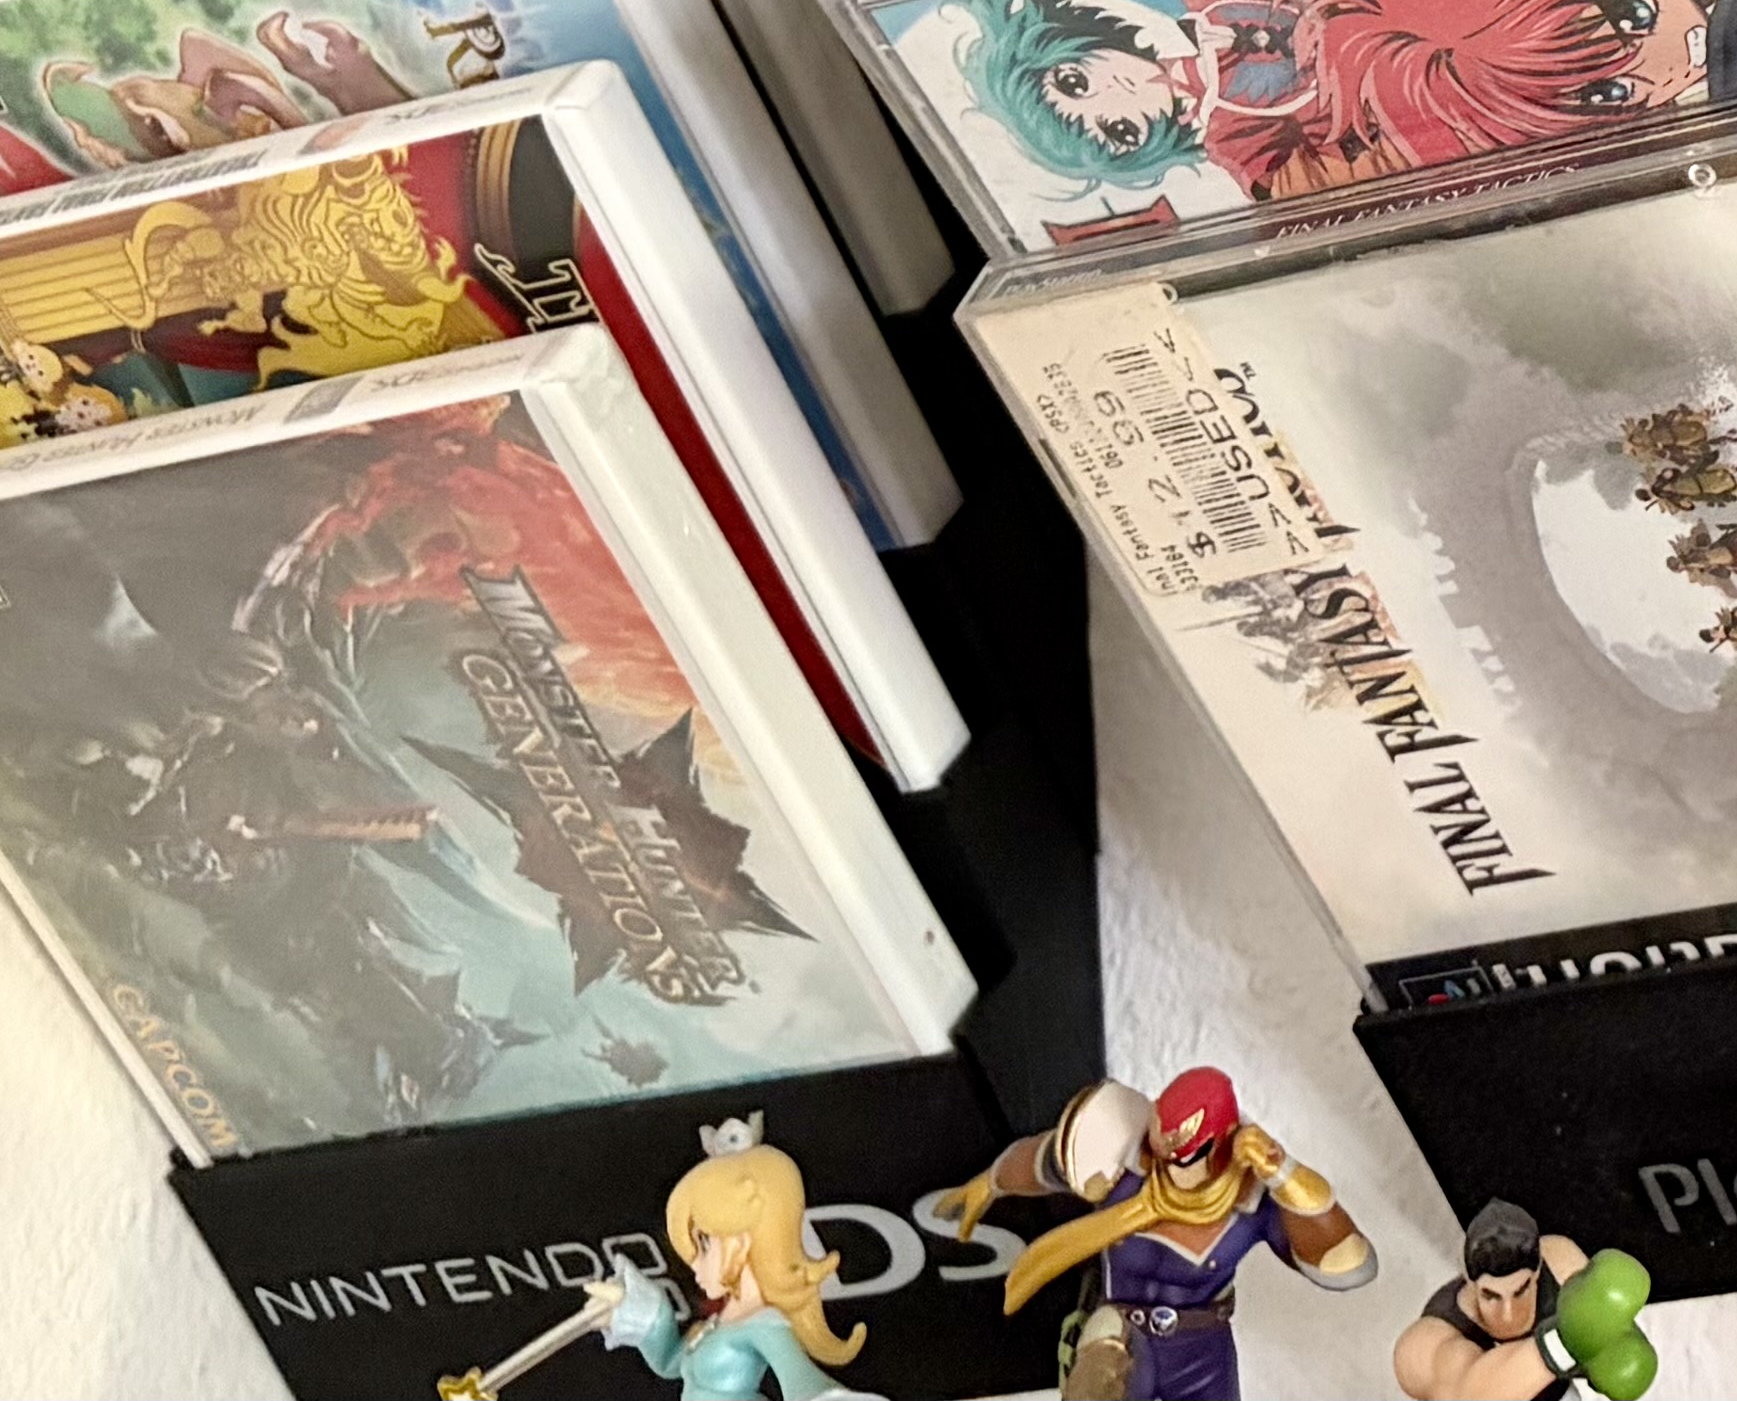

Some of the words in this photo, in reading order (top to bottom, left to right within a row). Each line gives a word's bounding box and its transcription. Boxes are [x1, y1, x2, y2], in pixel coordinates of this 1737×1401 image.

[1111, 503, 1151, 561] Fantasy
[1403, 760, 1557, 897] FINAL
[112, 984, 238, 1154] CAPCOM
